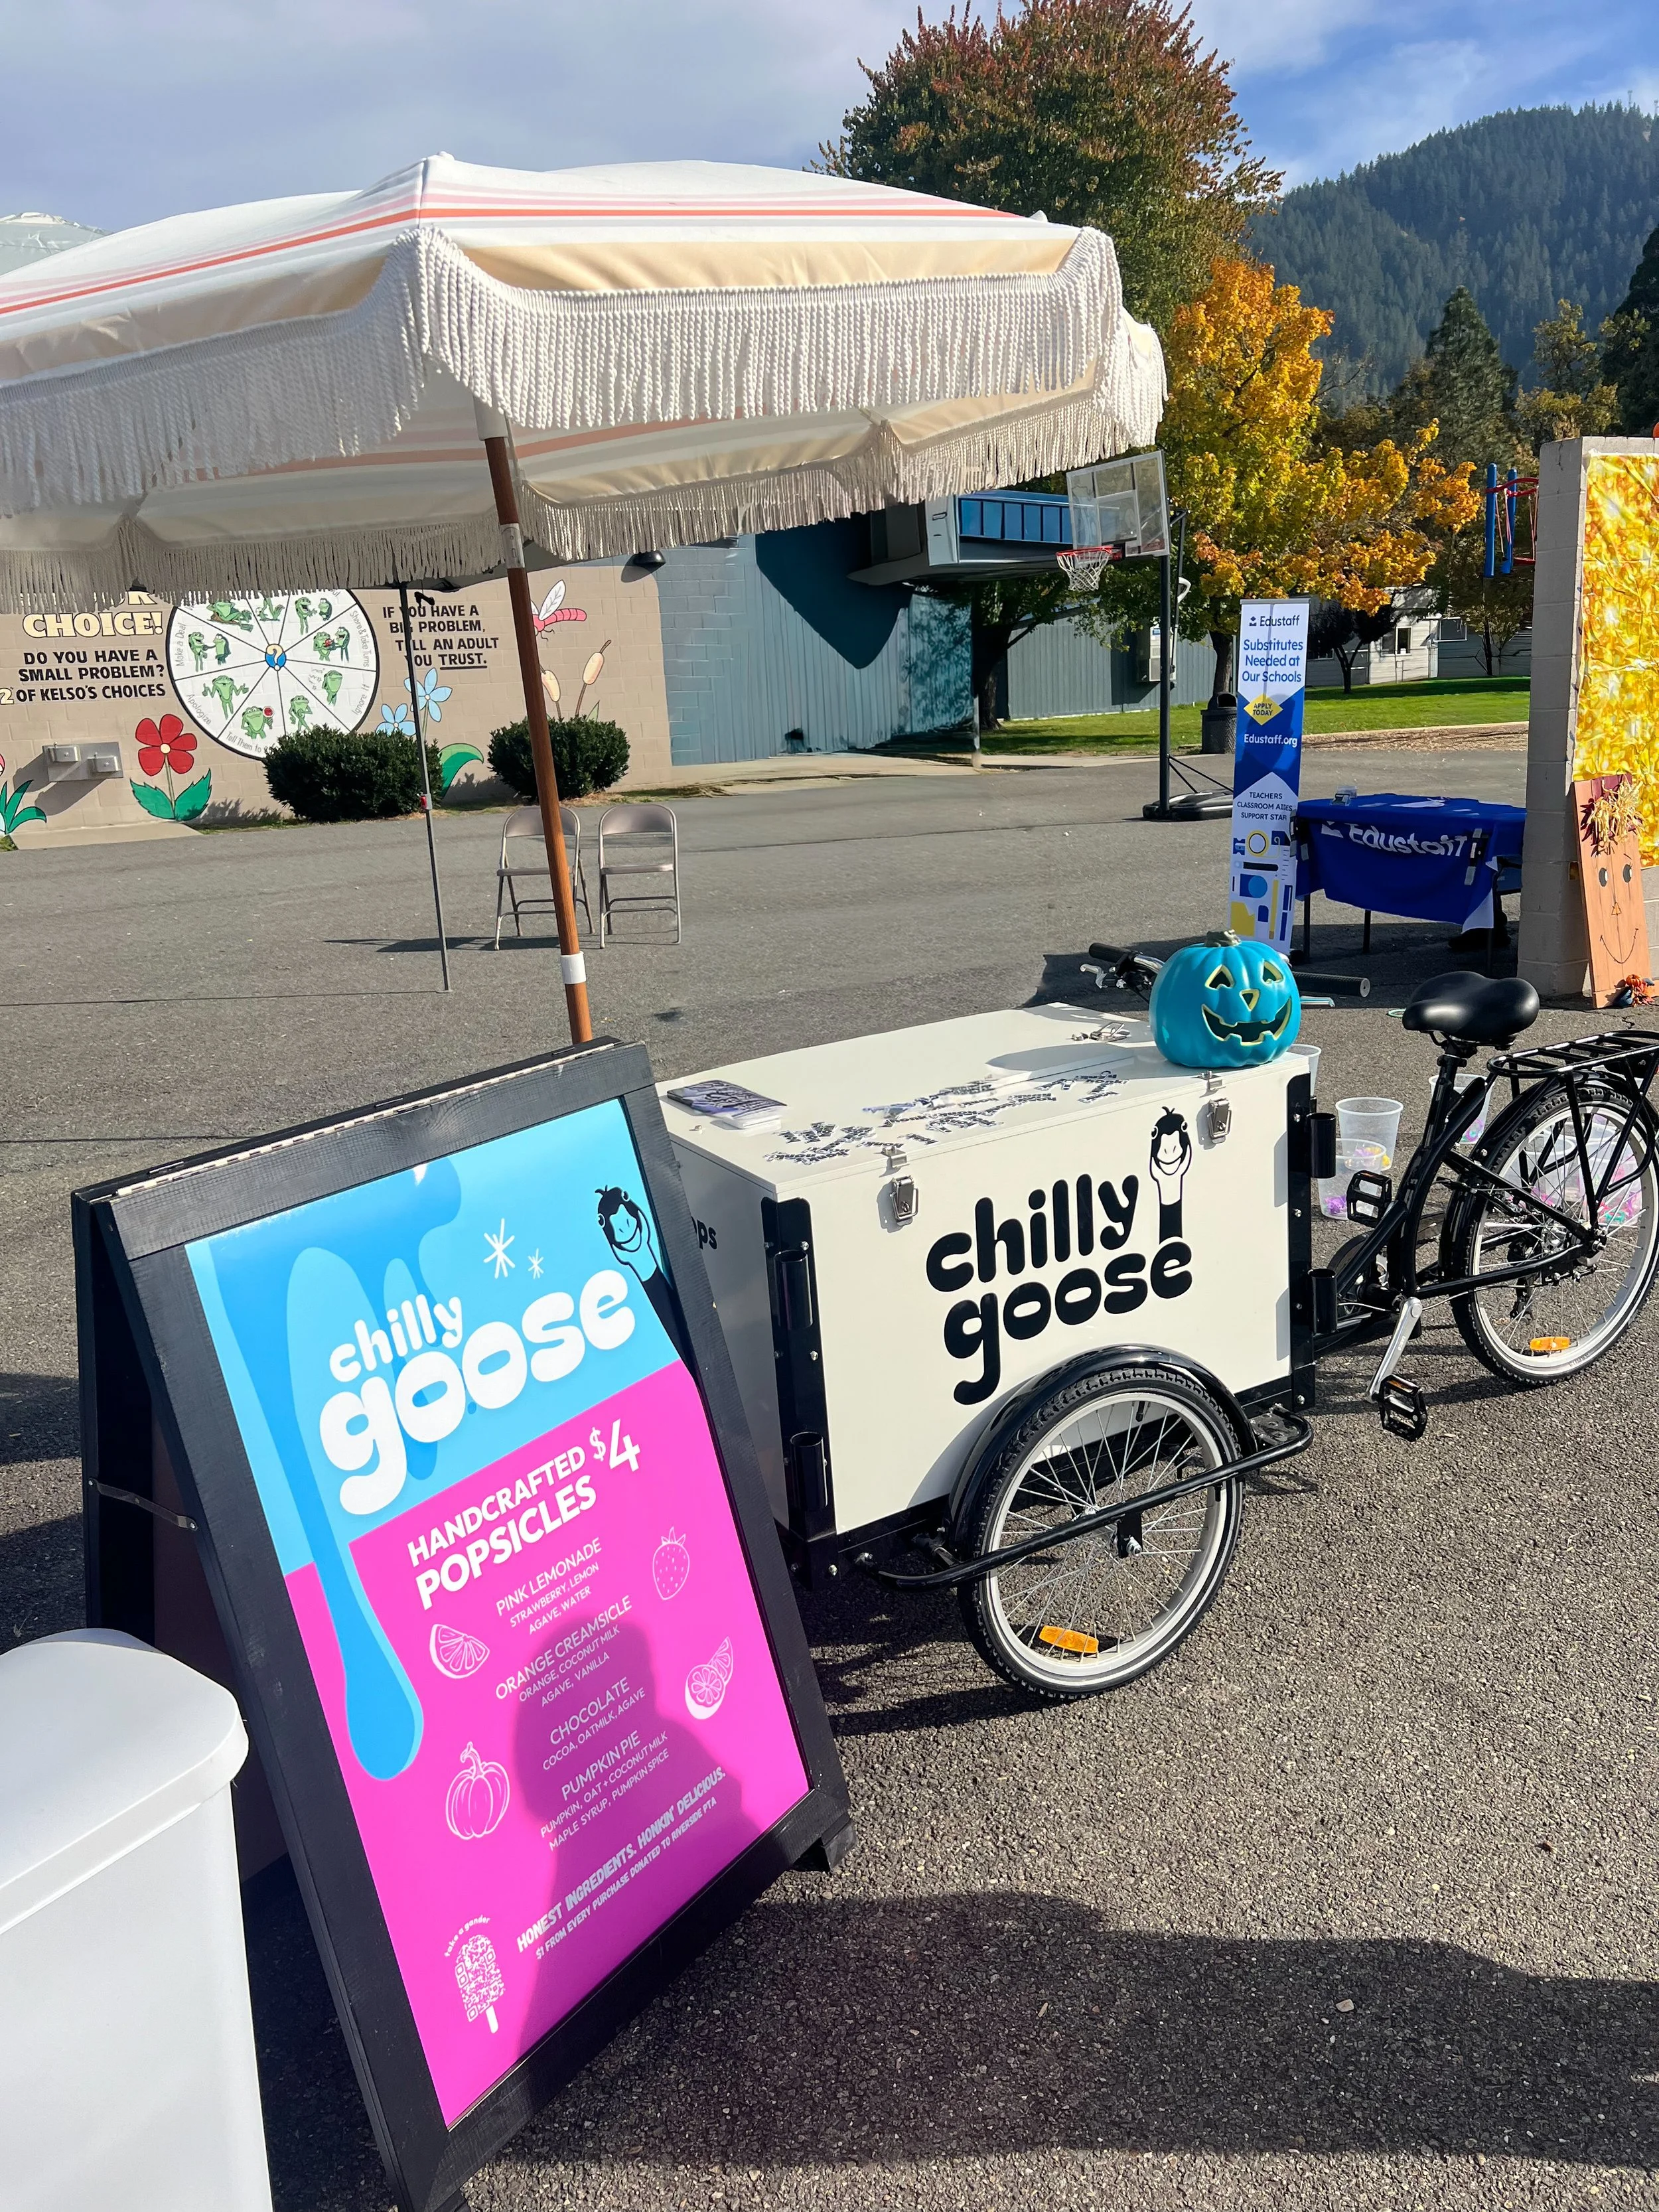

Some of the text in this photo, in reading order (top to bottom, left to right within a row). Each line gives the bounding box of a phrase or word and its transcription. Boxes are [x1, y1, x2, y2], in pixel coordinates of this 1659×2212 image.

[23, 612, 163, 638] CHOICE!
[383, 607, 394, 618] IF
[431, 605, 465, 617] HAVE
[470, 605, 479, 616] A
[419, 621, 484, 632] PROBLEM,
[1260, 615, 1300, 627] Edustaff
[24, 650, 158, 664] DO YOU HAVE A
[395, 638, 498, 651] TLL AN ADULT
[438, 653, 486, 665] TRUST.
[1243, 638, 1303, 651] Substitutes
[1245, 654, 1301, 667] Needed at
[17, 690, 36, 701] OF
[40, 686, 97, 701] KELSO'S
[102, 684, 165, 698] CHOICES
[19, 664, 164, 682] SMALL PROBLEM?
[1242, 670, 1301, 683] Our Schools
[1244, 733, 1298, 748] Edustaff.org
[1237, 801, 1274, 810] CLASSROOM
[1241, 812, 1269, 820] SUPPORT
[691, 1216, 717, 1250] ps
[926, 1173, 1139, 1292] chilly
[330, 1294, 463, 1382] chilly
[944, 1240, 1192, 1406] goose
[320, 1270, 635, 1514] goose
[407, 1446, 585, 1567] HANDCRAFTED
[415, 1475, 596, 1610] POPSICLES
[496, 1537, 601, 1616] PINK LEMONADE
[510, 1562, 599, 1627] STRAWBERRY, LEMON
[530, 1585, 591, 1634] AGAVE, WATER
[496, 1595, 632, 1699] ORANGE CREAMSICLE
[519, 1624, 620, 1702] ORANGE, COCONUT MILK
[541, 1651, 610, 1706] AGAVE, VANILLA
[543, 1687, 645, 1770] COCOA, OATMILK, AGAVE
[550, 1676, 630, 1744] CHOCOLATE
[540, 1800, 583, 1838] PUMPKIN,
[583, 1782, 601, 1803] OAT
[609, 1745, 648, 1783] COCONUT
[648, 1730, 668, 1751] MILK
[561, 1730, 640, 1801] PUMPKIN PIE
[549, 1747, 669, 1850] MAPLE SYRUP, PUMPKIN SPICE
[517, 1766, 725, 1953] HONEST INGREDIENTS. HONKIN' DELICIOUS.
[536, 1797, 717, 1959] $1 FROM EVERY PURCHASE DONATED TO RIVERSIDE PTA
